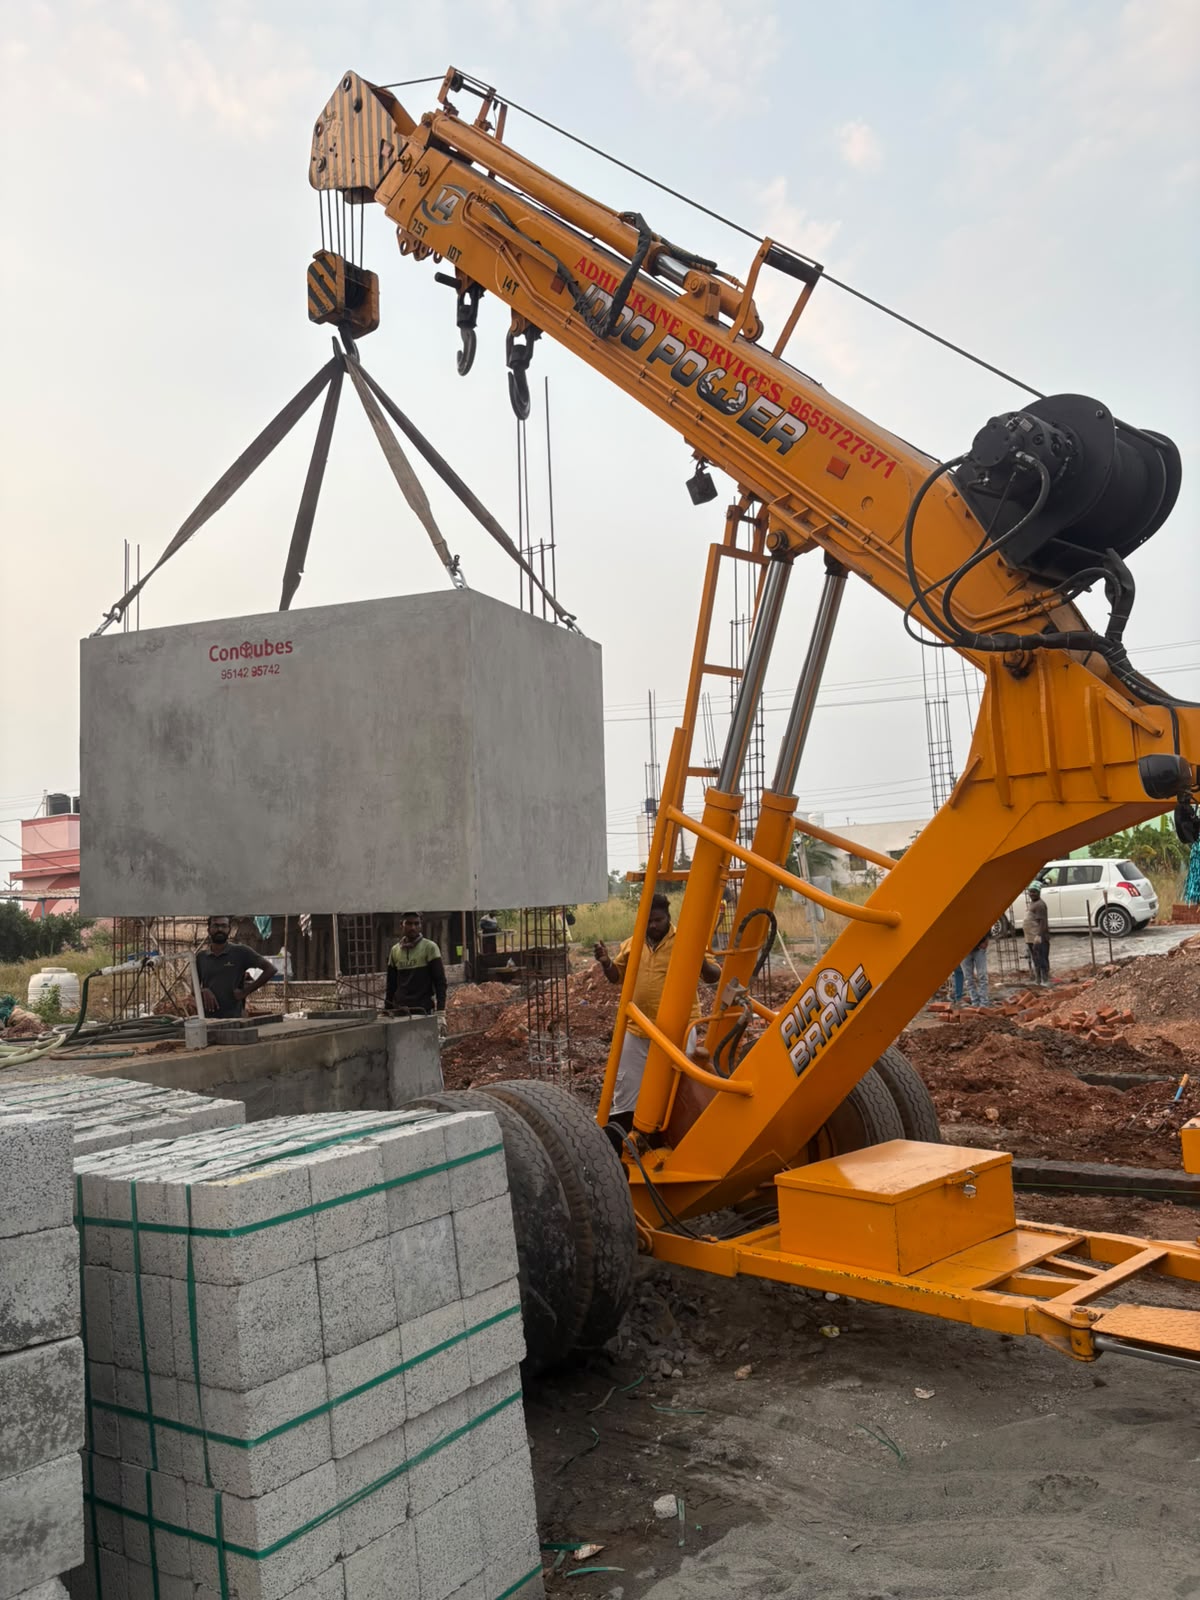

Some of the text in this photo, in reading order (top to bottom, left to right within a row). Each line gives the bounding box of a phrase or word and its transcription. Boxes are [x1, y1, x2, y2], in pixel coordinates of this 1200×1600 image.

[431, 187, 461, 221] 14
[446, 244, 463, 263] 10T
[502, 275, 520, 296] 14T
[574, 256, 619, 293] ADHI
[685, 328, 783, 403] SERVICES
[788, 395, 897, 480] 9655727371
[646, 333, 809, 456] POWER
[221, 664, 280, 680] 95142 95742
[780, 986, 821, 1050] AIR
[788, 963, 873, 1077] BRAKE
